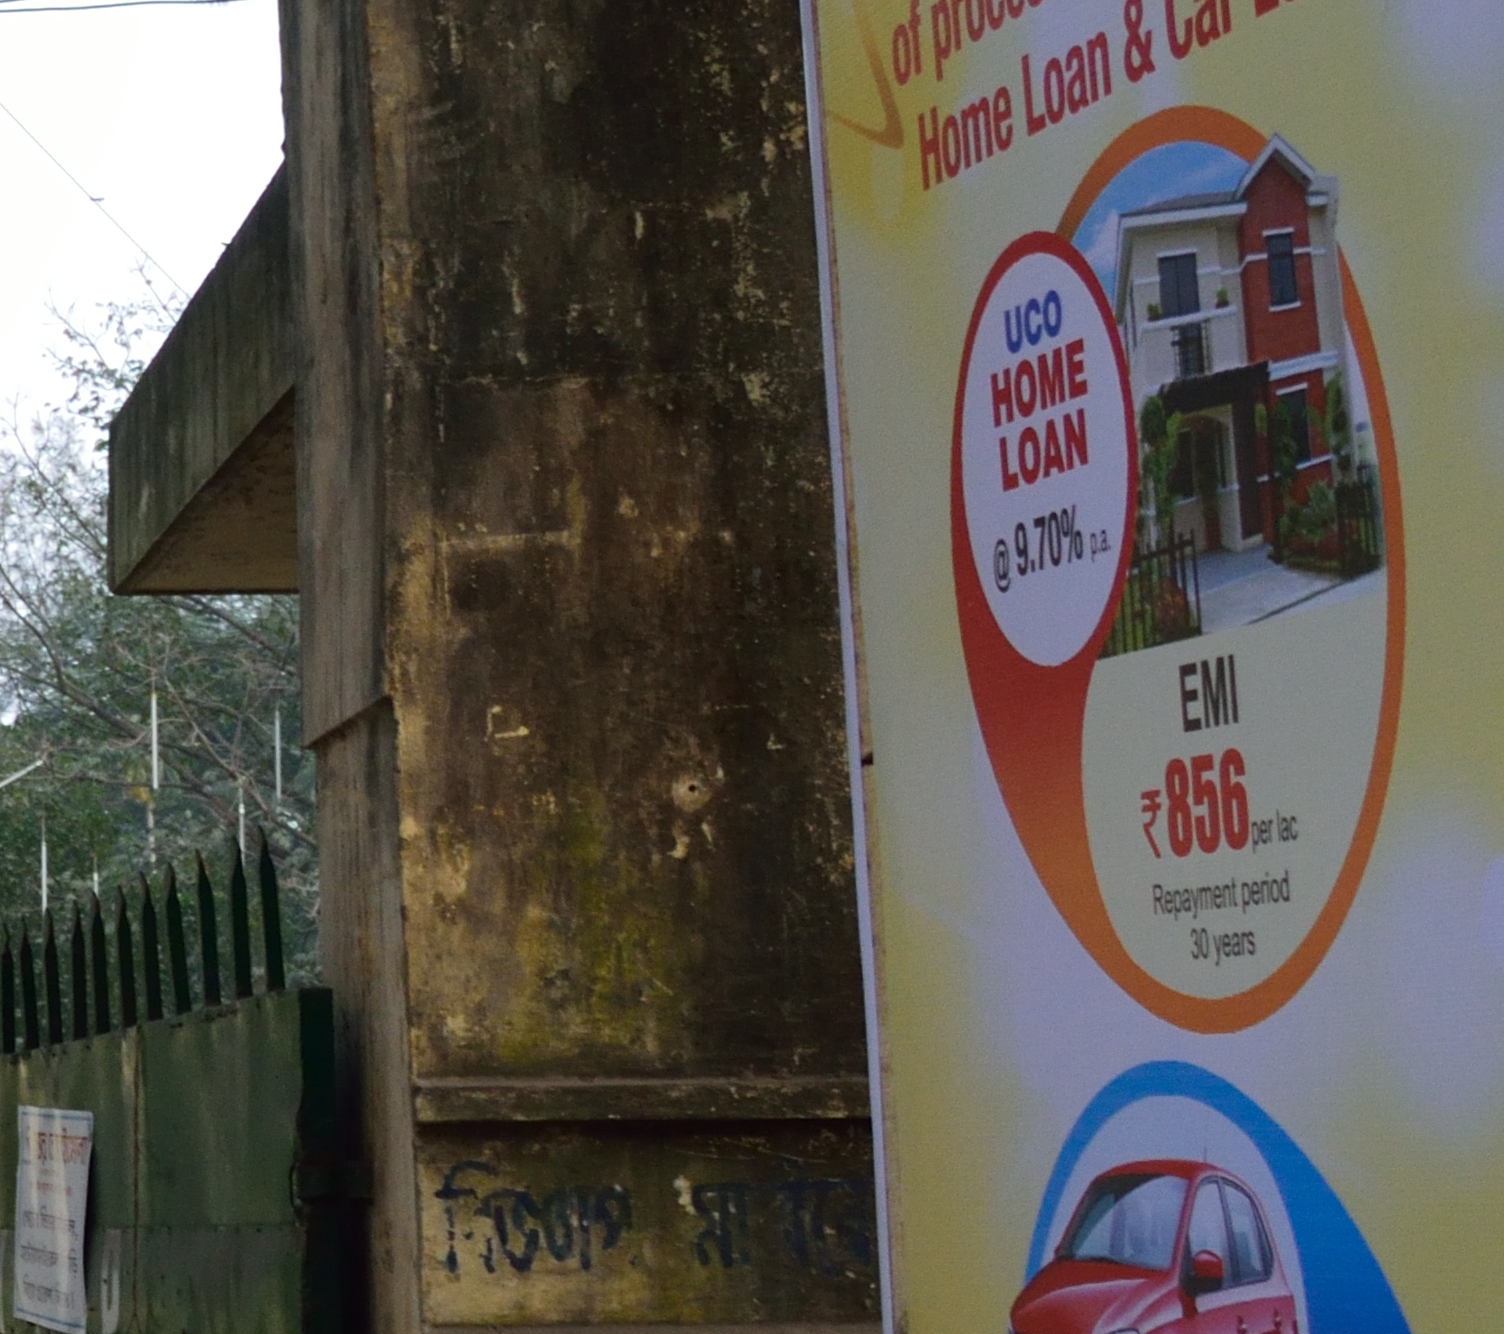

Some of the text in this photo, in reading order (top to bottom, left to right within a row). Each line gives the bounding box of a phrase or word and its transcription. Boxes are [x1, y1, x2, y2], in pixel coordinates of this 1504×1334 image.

[918, 91, 1015, 192] Home
[1023, 38, 1114, 137] Loan
[1003, 289, 1062, 354] UCO
[990, 337, 1088, 428] HOME
[998, 408, 1089, 493] LOAN
[993, 504, 1112, 593] @ 9.70% p.a.
[1178, 654, 1239, 733] EMI
[1140, 747, 1299, 860] ₹856 per lac
[1152, 869, 1291, 921] Repayment period
[1190, 926, 1256, 967] 30 years
